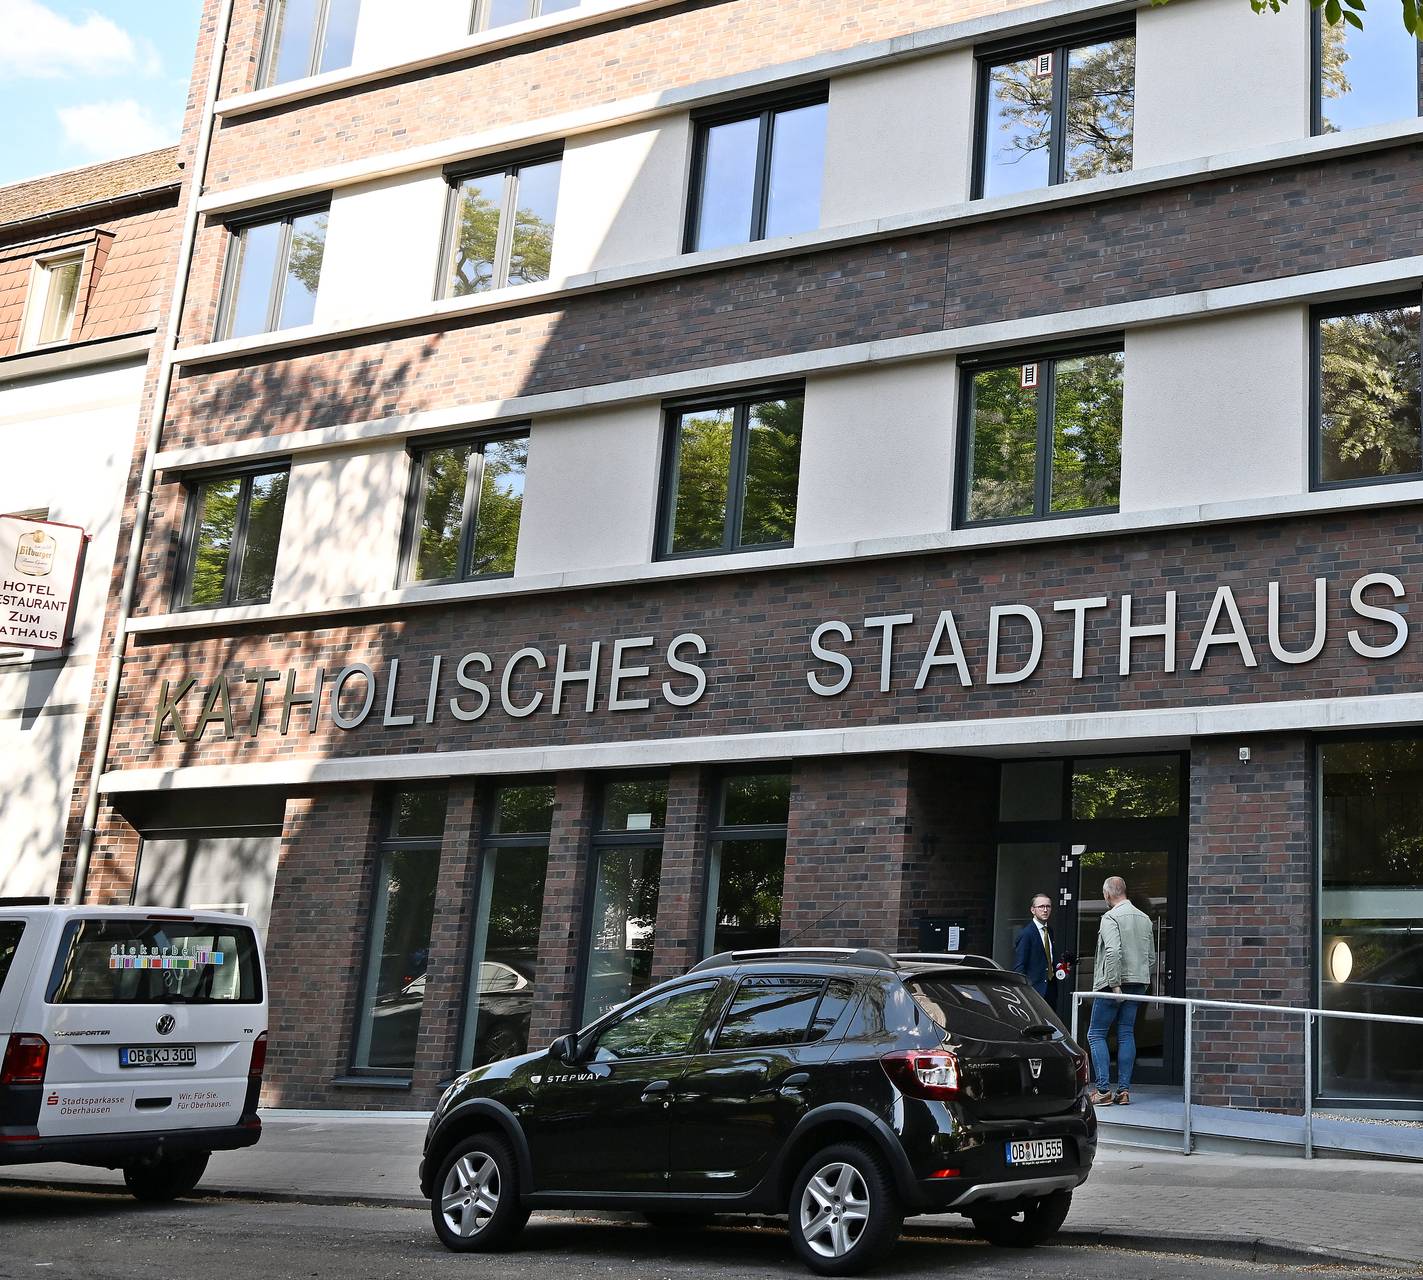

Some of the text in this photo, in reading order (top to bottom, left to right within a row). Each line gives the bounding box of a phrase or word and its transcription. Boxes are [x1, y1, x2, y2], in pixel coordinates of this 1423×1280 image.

[3, 580, 55, 596] HOTEL
[9, 610, 40, 624] ZUM
[152, 572, 1409, 744] KATHOLISCHES STADTHAUS
[129, 1048, 194, 1062] OB KJ 300
[547, 1072, 601, 1083] STEPWAY
[62, 1097, 125, 1106] Stadtsparkasse
[194, 1092, 205, 1100] Für
[60, 1107, 111, 1115] Oberhausen
[177, 1102, 189, 1110] Für
[1012, 1141, 1062, 1160] OB VD 555
